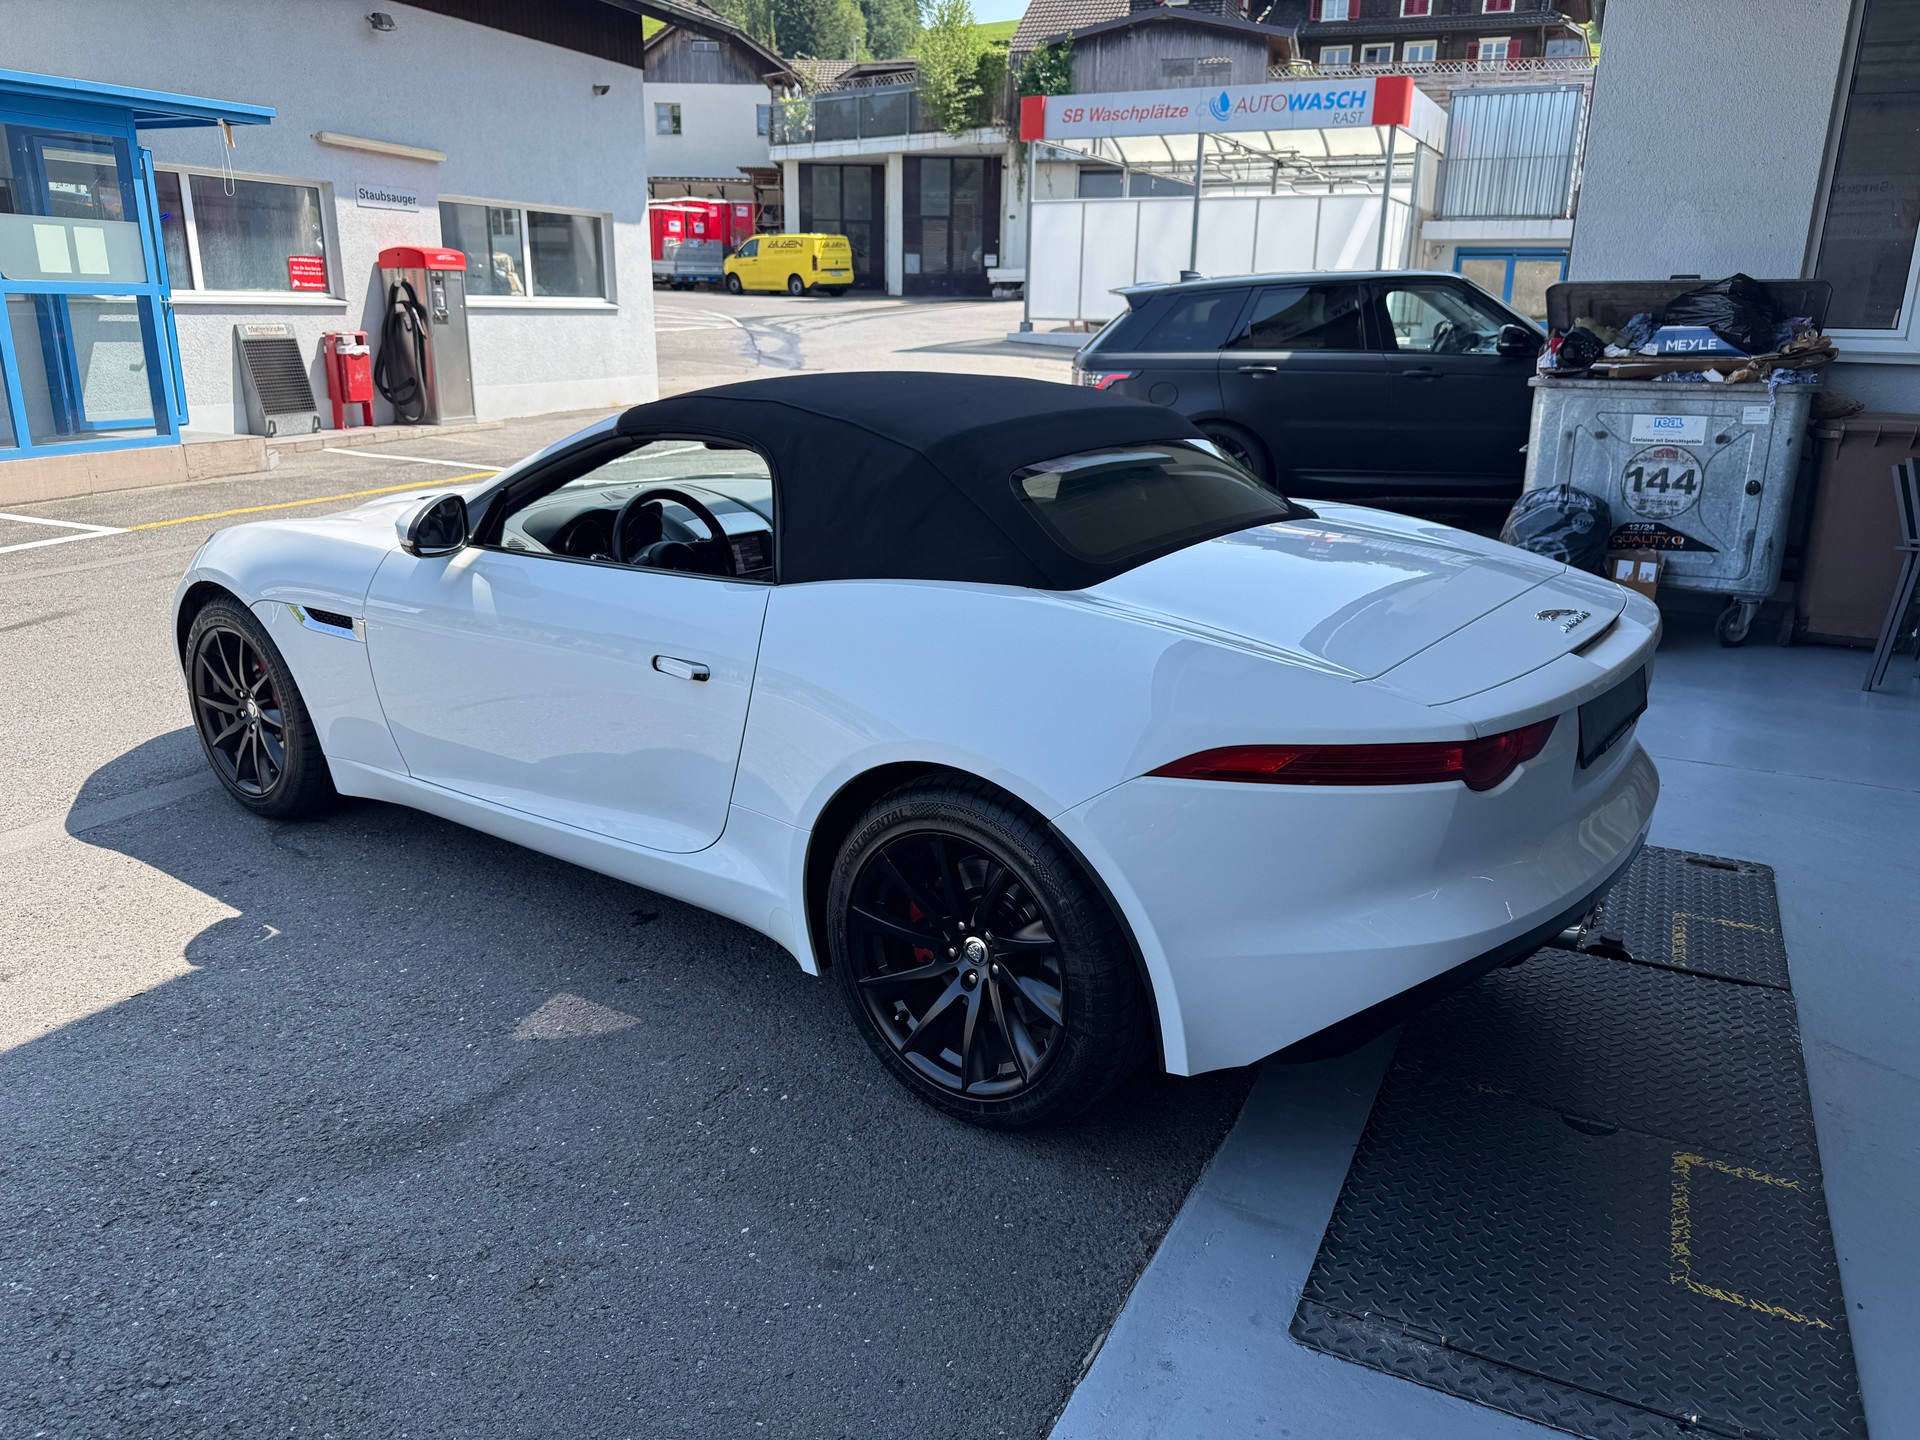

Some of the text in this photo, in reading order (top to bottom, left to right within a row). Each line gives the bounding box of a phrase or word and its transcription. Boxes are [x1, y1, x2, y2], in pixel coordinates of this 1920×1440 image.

[1234, 90, 1367, 113] AUTOWASCH
[1062, 108, 1084, 123] SB
[1089, 104, 1189, 123] Waschplätze
[1332, 111, 1365, 124] RAST
[358, 188, 417, 206] Staubsauger
[1665, 338, 1718, 351] MEYLE
[1654, 417, 1684, 428] real
[1625, 467, 1697, 495] 144
[1628, 523, 1656, 531] 12/24
[1612, 535, 1671, 544] QUALITY
[318, 625, 346, 635] JAGUAR
[840, 808, 908, 875] CONTINENTAL
